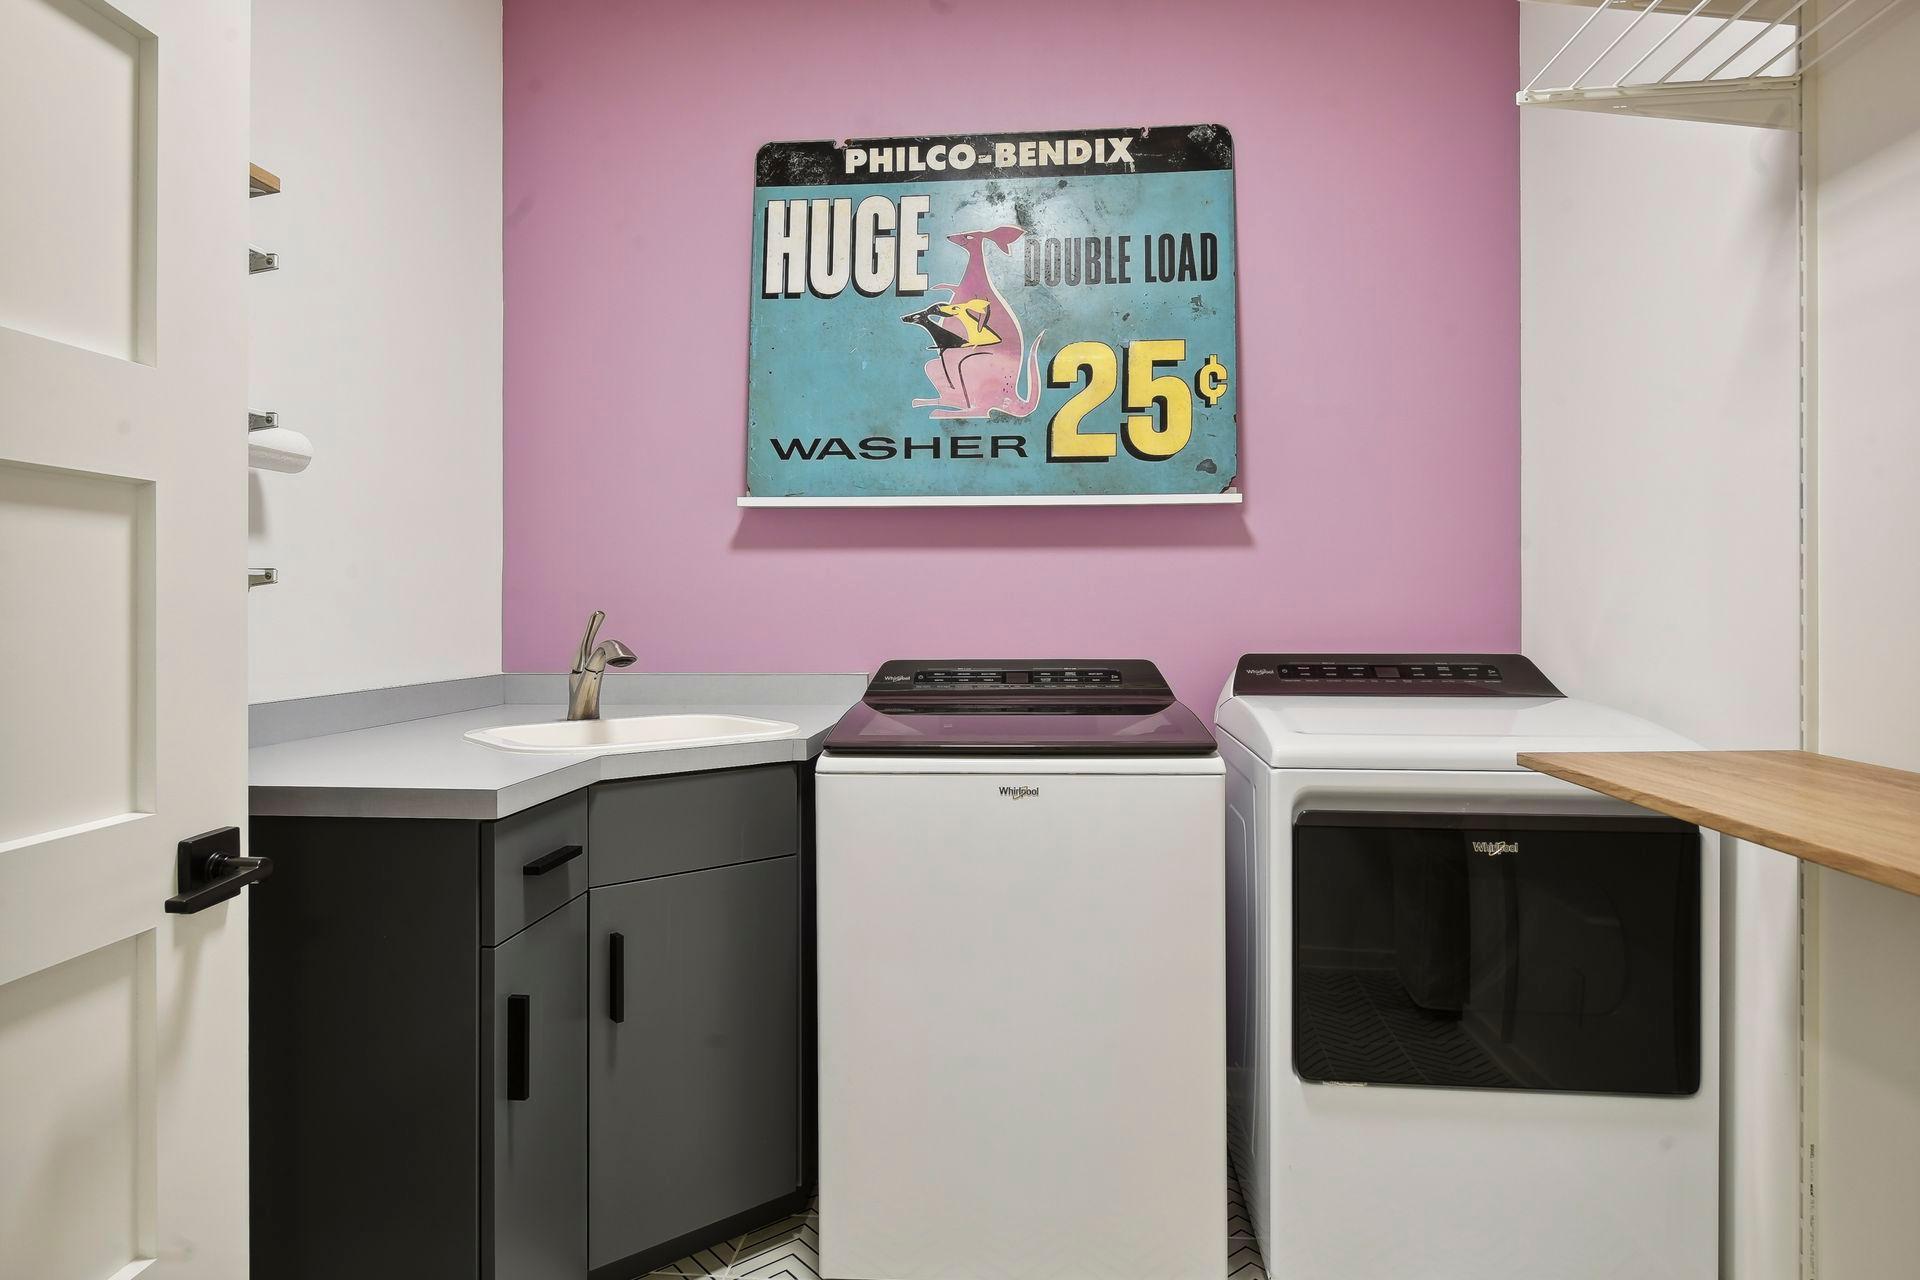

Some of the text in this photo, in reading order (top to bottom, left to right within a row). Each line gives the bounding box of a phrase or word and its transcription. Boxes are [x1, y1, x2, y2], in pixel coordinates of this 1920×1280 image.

[845, 137, 1136, 174] PHILCO-BENDIX
[761, 195, 931, 299] HUGE
[1023, 232, 1218, 288] DOUBLE LOAD
[770, 435, 1029, 461] WASHER
[999, 786, 1039, 799] Whirlpool
[1472, 841, 1518, 856] Whirlpool
